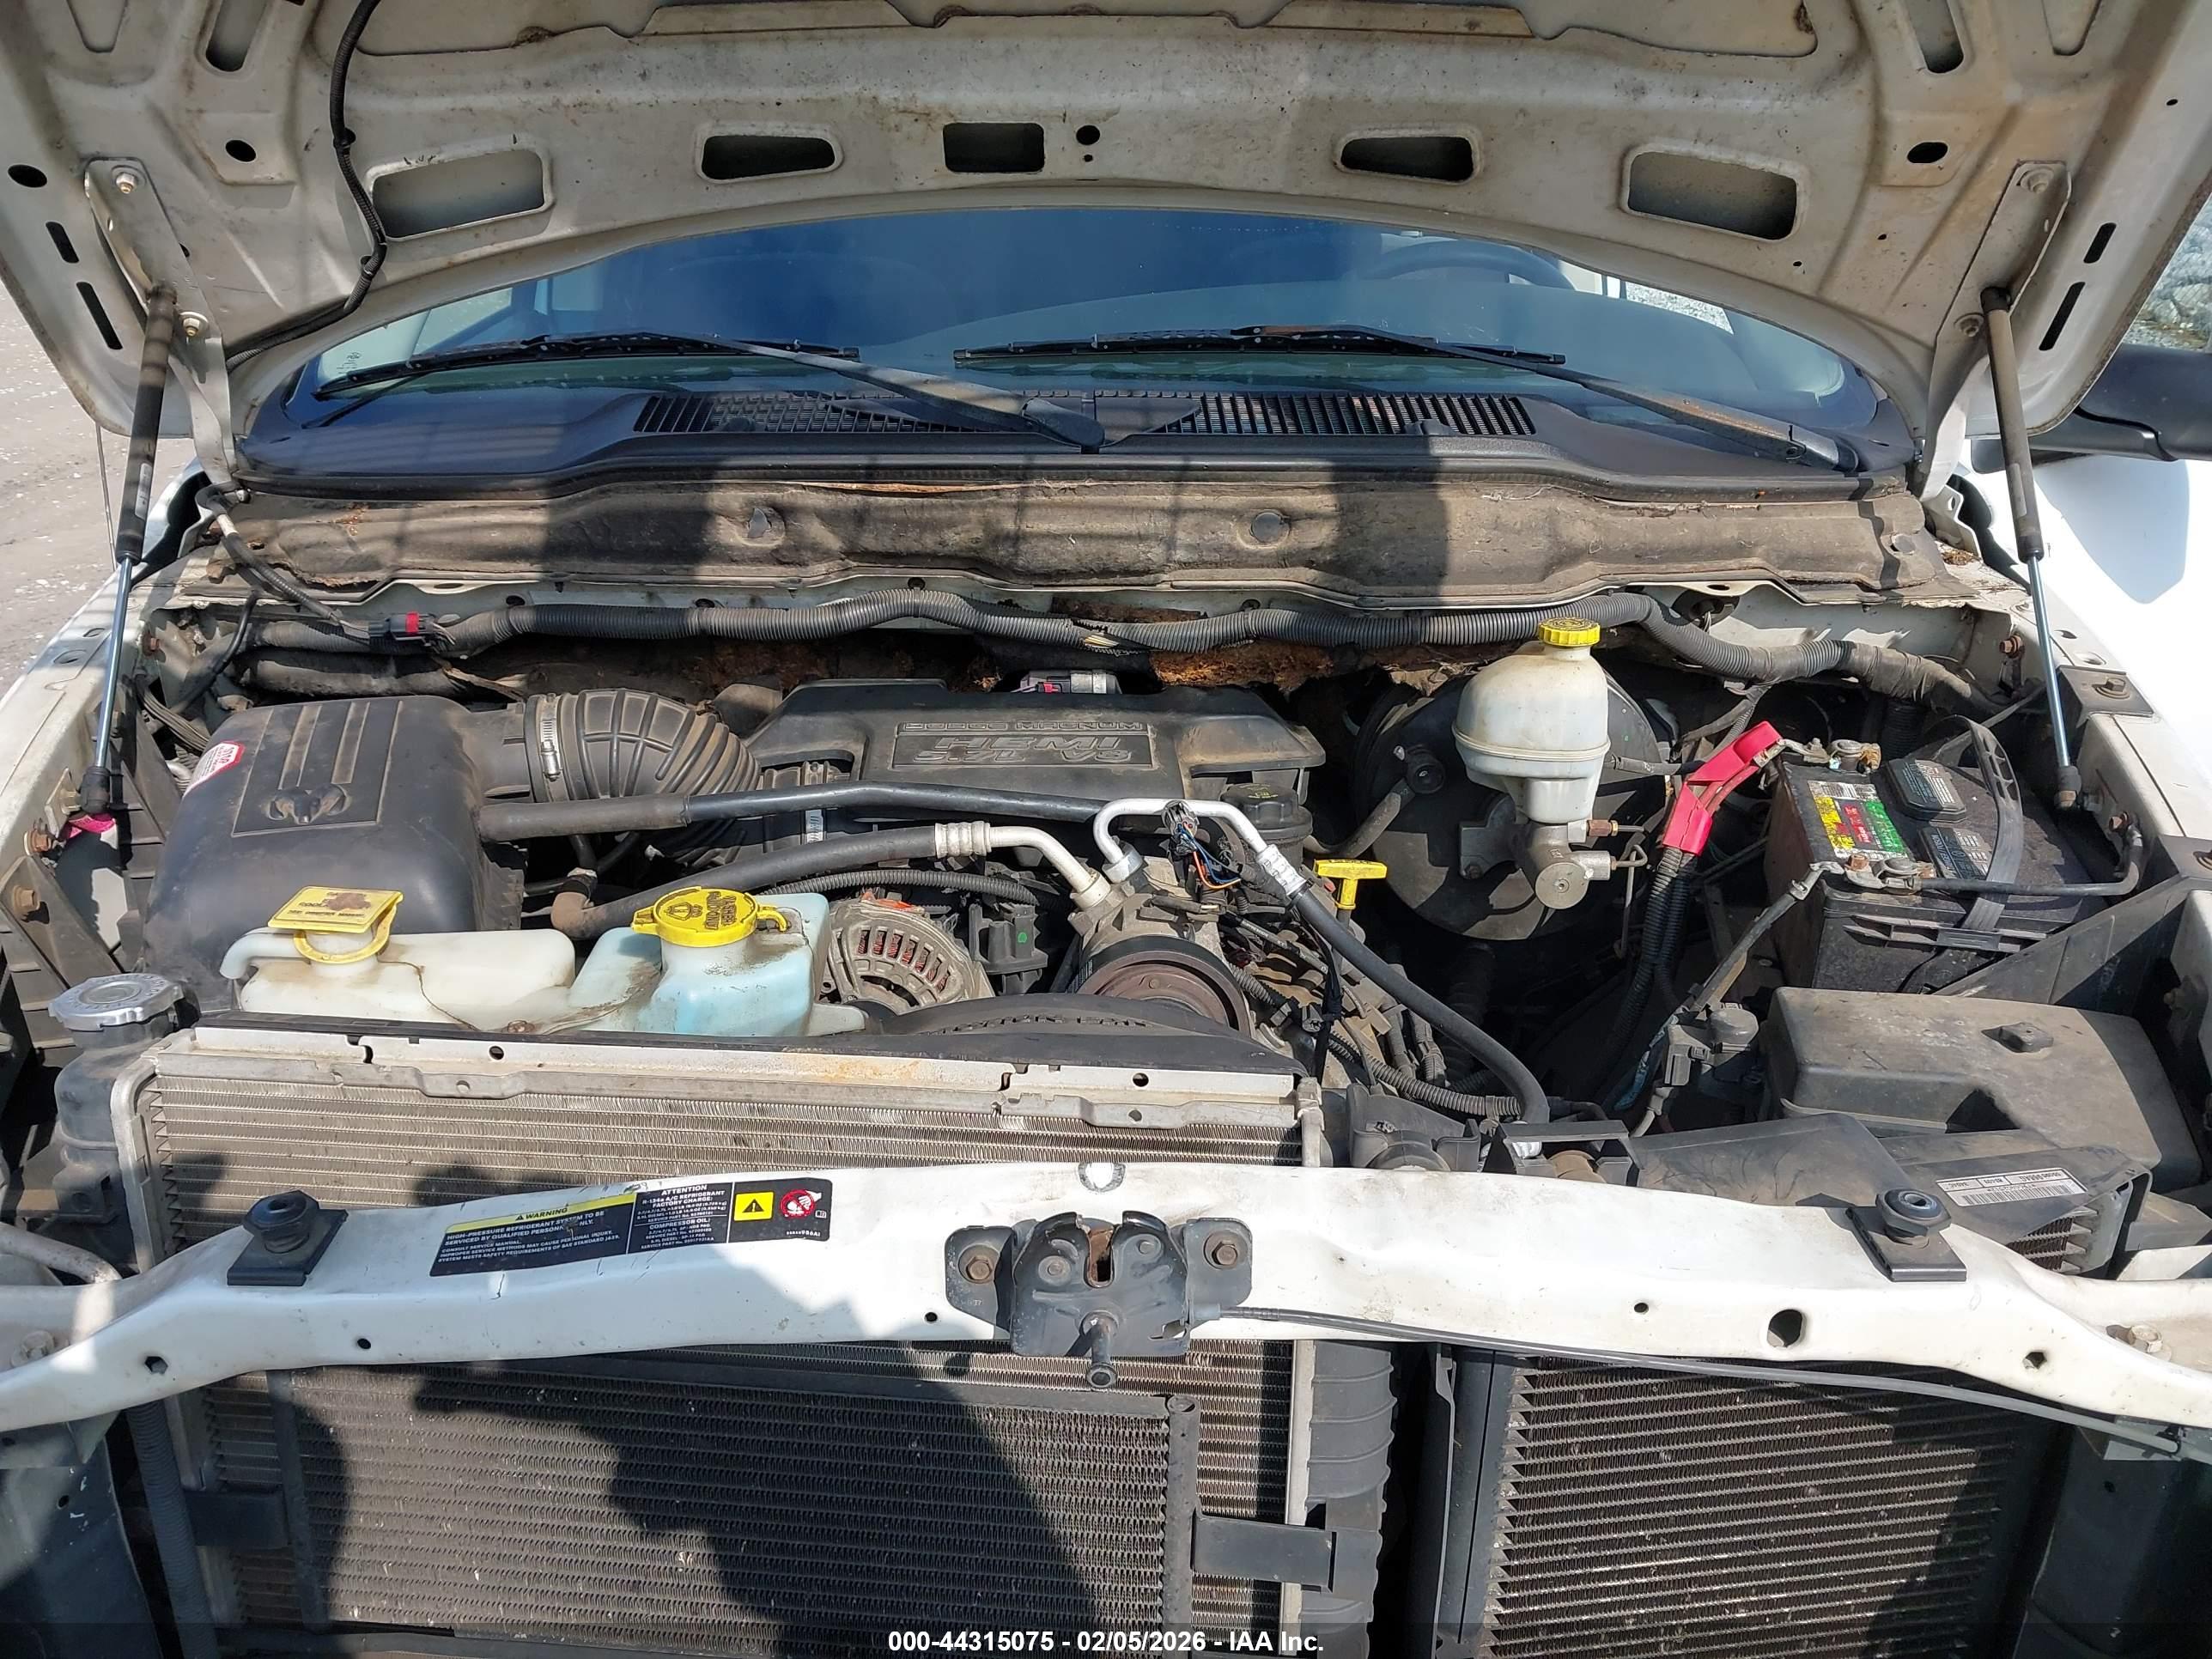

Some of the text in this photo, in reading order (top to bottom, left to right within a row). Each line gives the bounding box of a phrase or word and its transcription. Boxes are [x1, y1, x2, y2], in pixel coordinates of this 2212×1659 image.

[903, 720, 1143, 730] DODGE MAGNUM
[934, 737, 1120, 750] HEMI
[913, 749, 1132, 763] 5.7L V8
[661, 1185, 708, 1196] ATTENTION
[679, 1189, 725, 1200] REFRIGERANT
[525, 1207, 568, 1218] WARNING
[447, 1227, 504, 1240] HIGH-PRESSURE
[505, 1220, 553, 1232] REFRIGERANT
[649, 1218, 695, 1229] COMPRESSOR
[445, 1237, 479, 1246] SERVICED
[491, 1230, 529, 1240] QUALIFIED
[530, 1224, 563, 1234] PERSONN
[440, 1249, 469, 1258] IMPROPER
[495, 1243, 525, 1252] METHODS
[441, 1238, 521, 1254] CONSULT SERVICE MANUAL.
[481, 1250, 505, 1259] SAFETY
[505, 1244, 551, 1256] REQUIREMENTS
[573, 1237, 604, 1246] STANDARD
